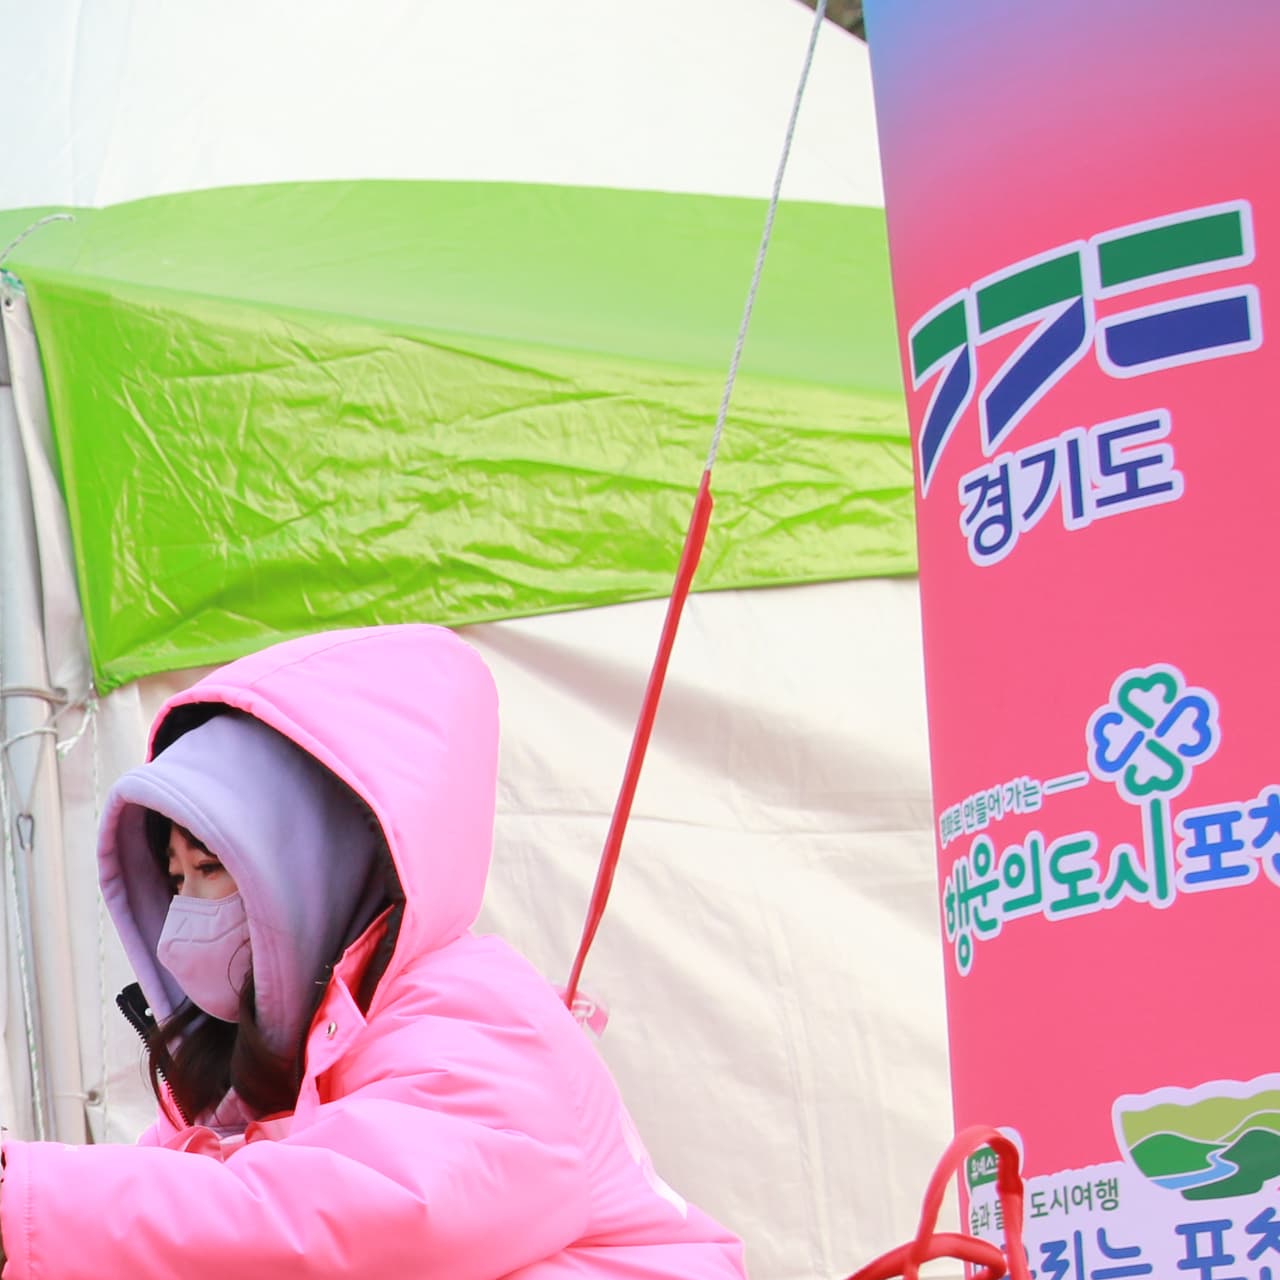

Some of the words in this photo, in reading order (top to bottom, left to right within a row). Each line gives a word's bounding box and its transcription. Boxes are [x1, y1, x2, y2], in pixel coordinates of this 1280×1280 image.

[963, 418, 1174, 556] 경기도
[963, 791, 1001, 829] 만들어
[1006, 781, 1040, 810] 가는
[1030, 1177, 1119, 1219] 도시여행
